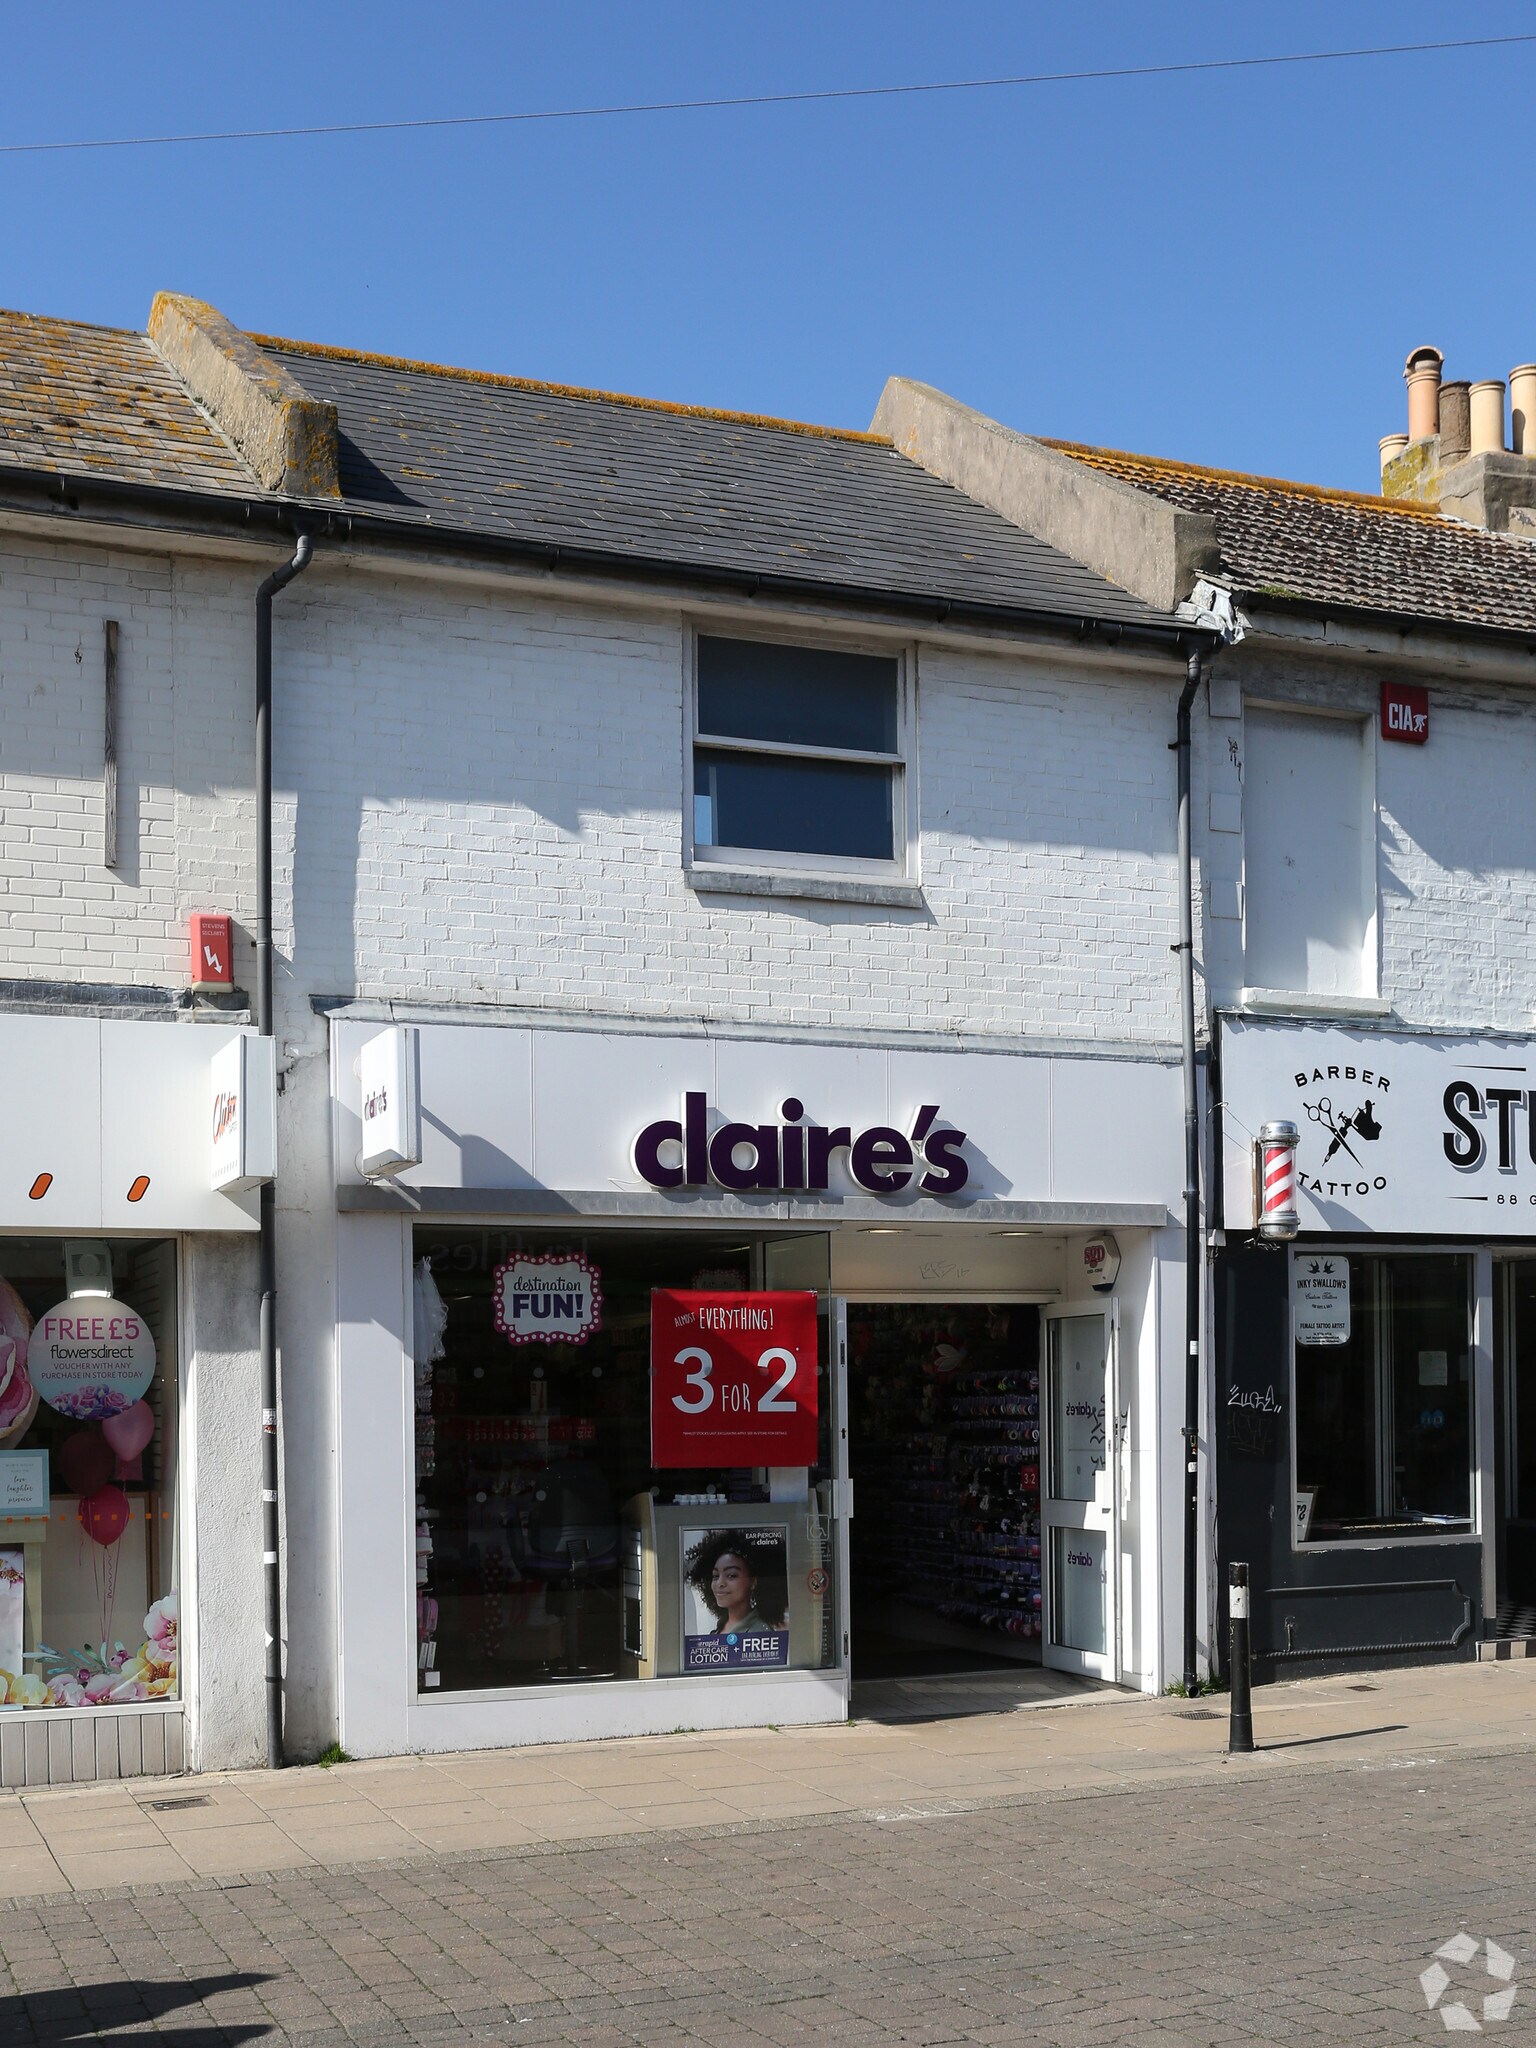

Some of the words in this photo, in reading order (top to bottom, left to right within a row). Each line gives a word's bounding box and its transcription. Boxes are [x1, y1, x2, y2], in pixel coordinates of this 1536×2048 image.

[1389, 703, 1413, 731] CIA
[1295, 1066, 1390, 1092] BARBER
[1443, 1081, 1536, 1175] ST
[634, 1091, 969, 1194] claire's
[1299, 1172, 1387, 1196] TATTOO
[1497, 1195, 1518, 1205] 88
[514, 1276, 581, 1291] destination
[1312, 1279, 1347, 1289] SWALLOWS
[513, 1294, 583, 1319] FUN!
[44, 1318, 105, 1340] FREE
[109, 1317, 140, 1340] £5
[674, 1312, 697, 1328] ALMOST
[699, 1307, 774, 1330] EVERYTHING!
[50, 1344, 134, 1359] flowersdirect
[53, 1362, 90, 1370] VOUCHER
[117, 1371, 144, 1379] TODAY
[671, 1346, 715, 1414] 3
[721, 1383, 750, 1412] FOR
[742, 1637, 779, 1652] FREE
[691, 1653, 728, 1664] LOTION
